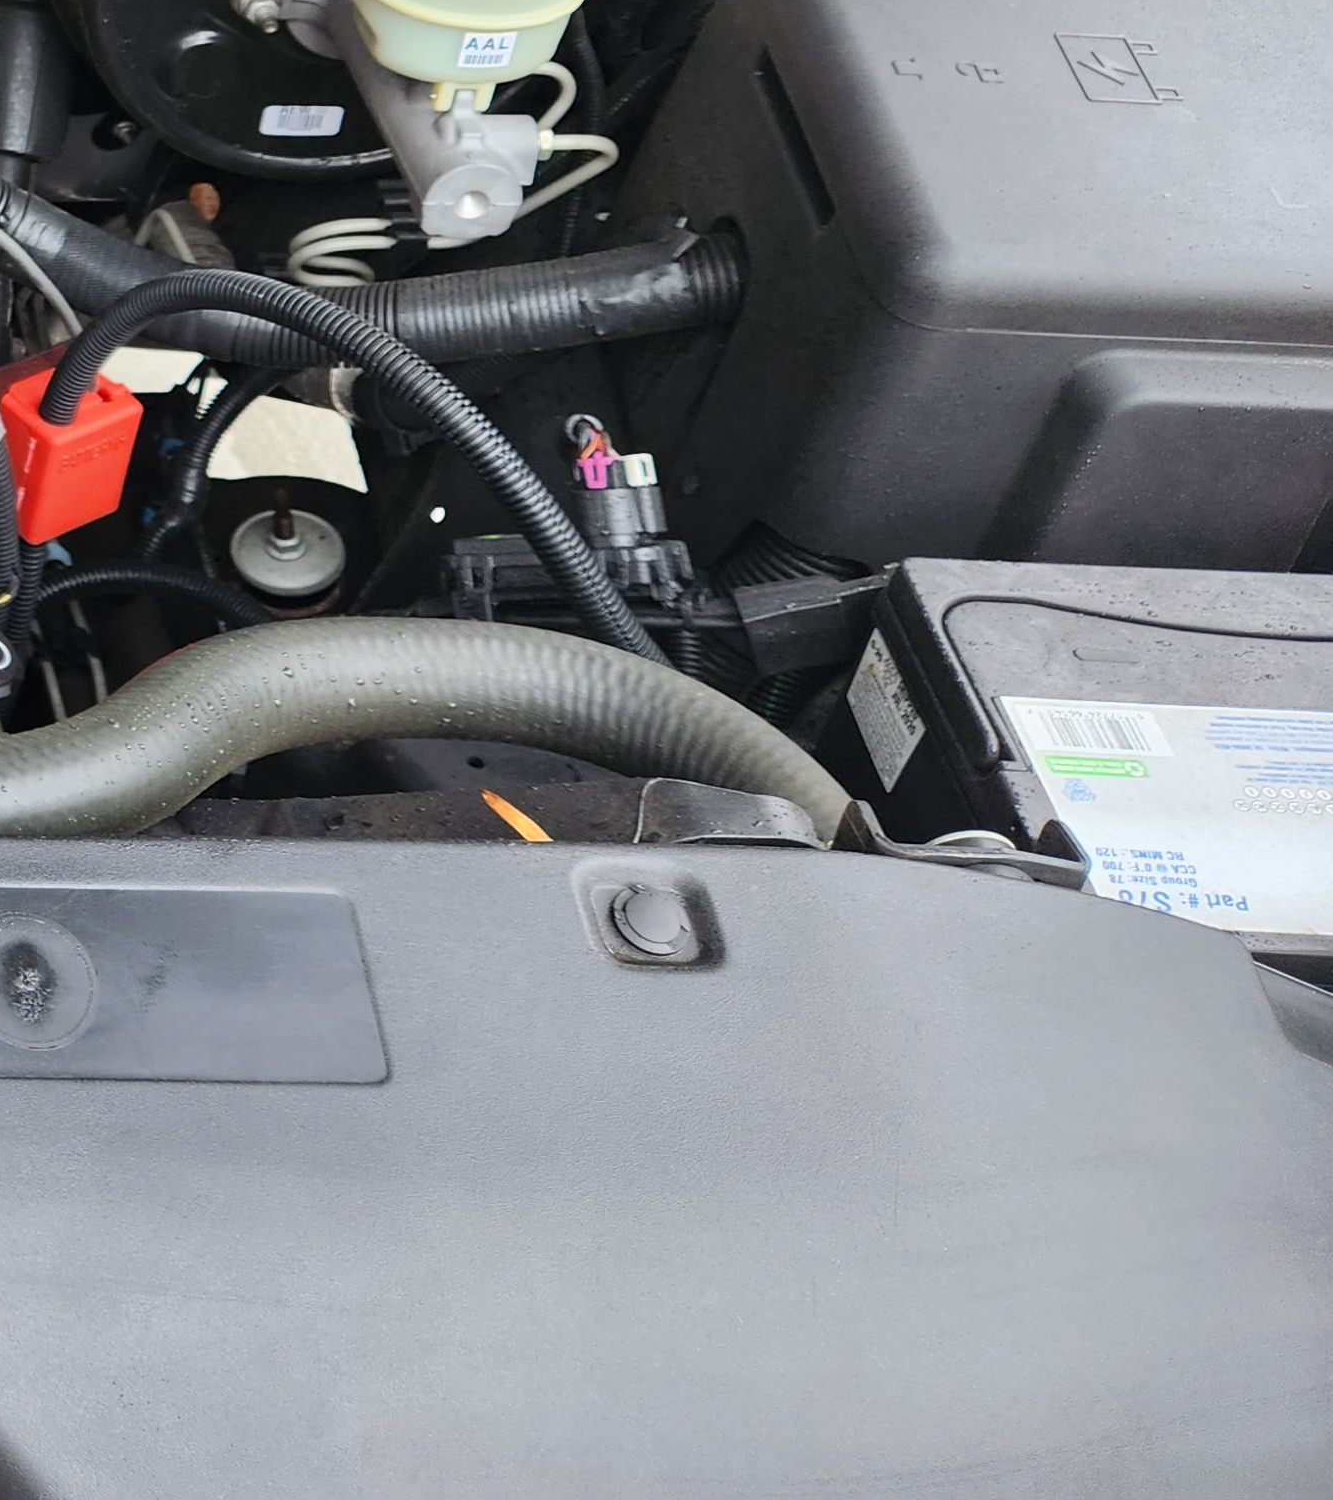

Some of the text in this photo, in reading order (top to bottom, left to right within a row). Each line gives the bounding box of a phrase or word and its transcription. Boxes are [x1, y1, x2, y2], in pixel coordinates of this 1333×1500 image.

[465, 36, 510, 51] AAL
[1096, 848, 1118, 858] 120
[1166, 851, 1184, 861] RC
[1102, 861, 1124, 872] 700
[1171, 864, 1197, 874] CCA
[1108, 874, 1198, 888] Group Size: 78
[1204, 893, 1249, 912] Part
